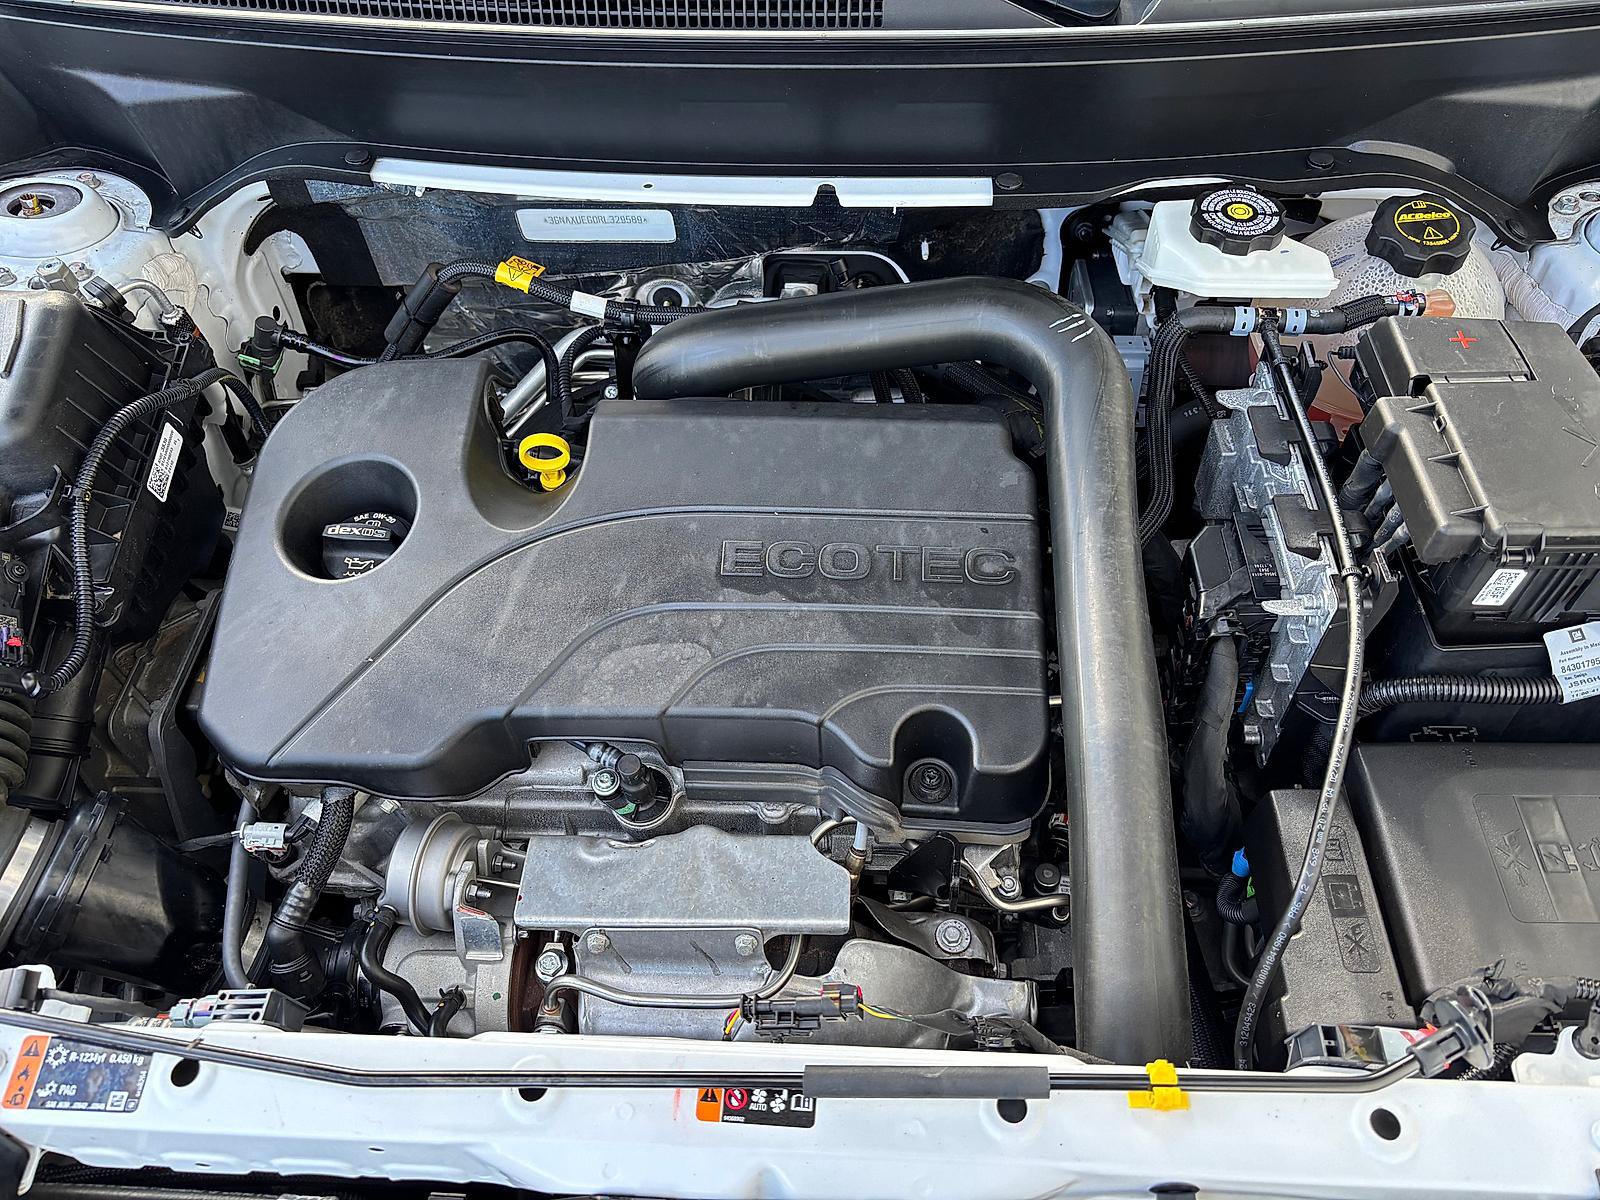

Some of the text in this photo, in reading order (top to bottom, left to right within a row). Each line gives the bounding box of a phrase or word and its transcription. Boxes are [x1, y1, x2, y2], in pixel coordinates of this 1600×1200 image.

[354, 513, 370, 522] SAE
[720, 540, 1016, 584] ECOTEC
[1240, 1002, 1256, 1047] 312049423
[58, 1084, 77, 1096] PAG
[749, 1103, 767, 1111] AUTO
